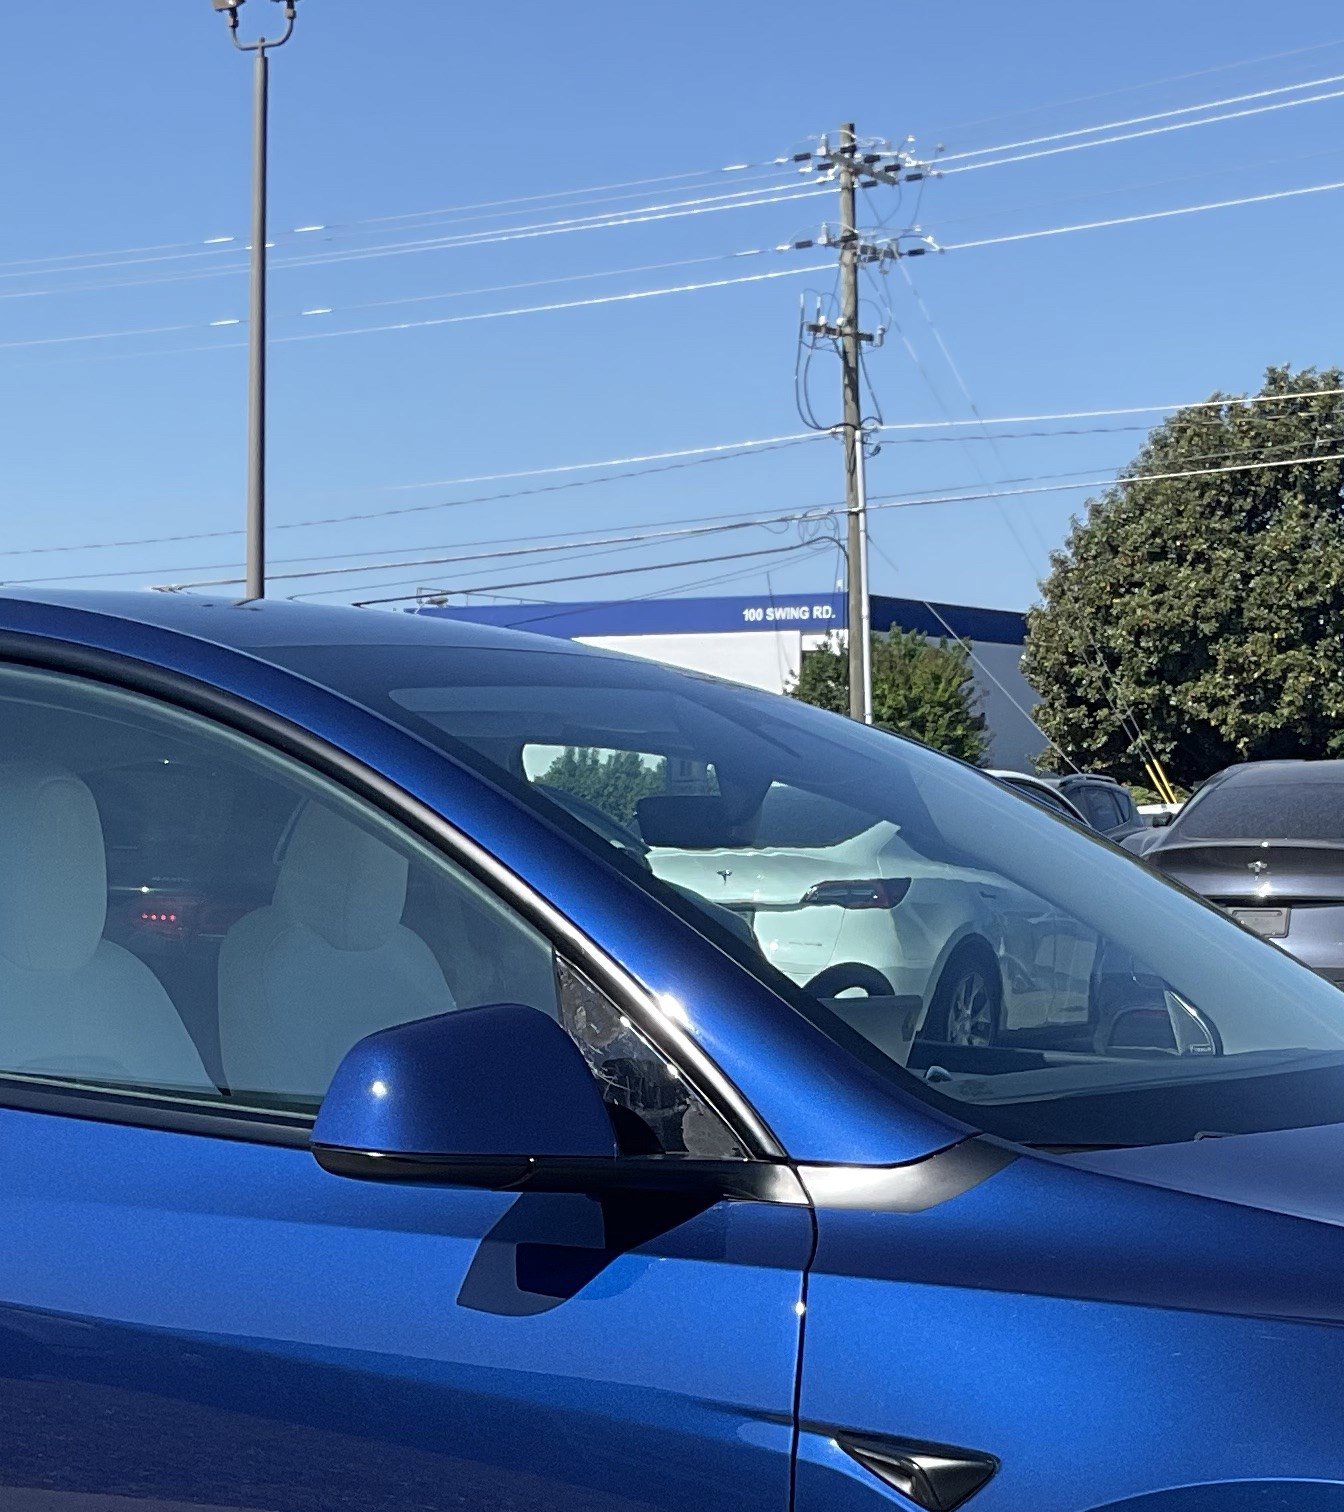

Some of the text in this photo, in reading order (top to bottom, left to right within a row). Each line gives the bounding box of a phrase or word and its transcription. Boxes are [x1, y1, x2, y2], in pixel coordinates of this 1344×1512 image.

[743, 605, 836, 621] 100 SWING RD.
